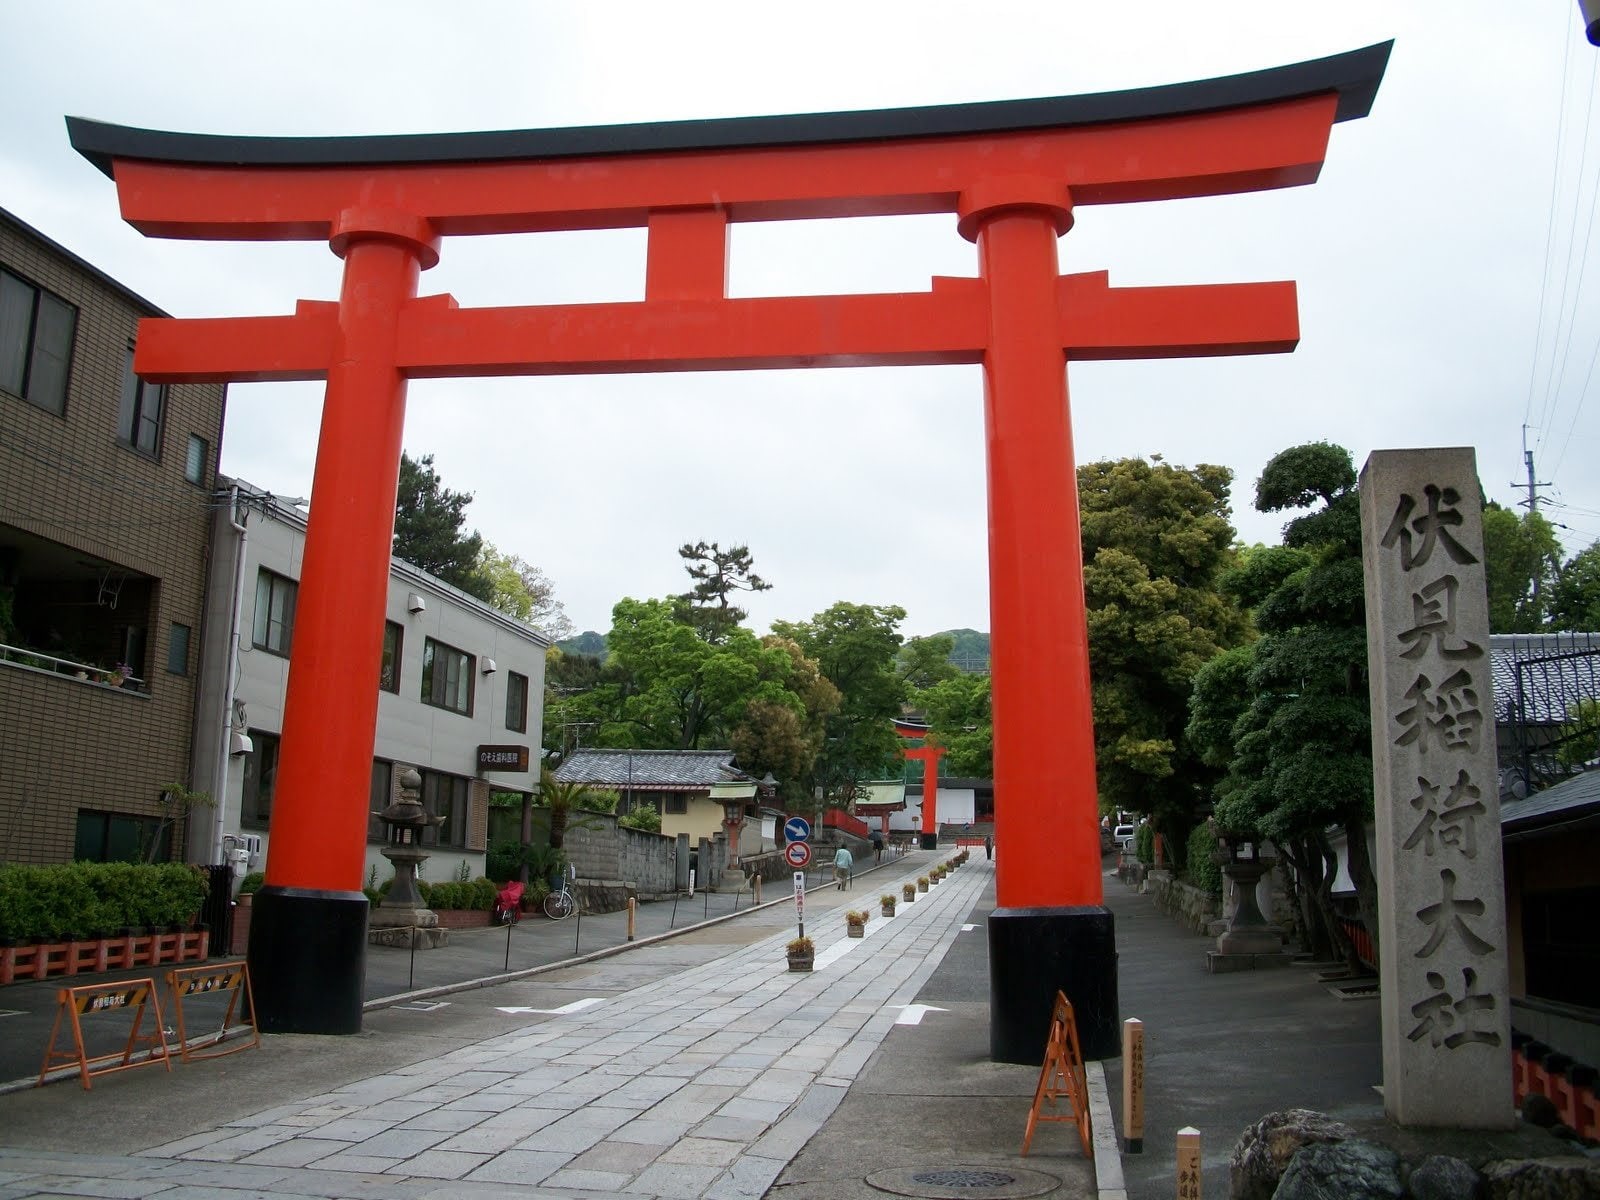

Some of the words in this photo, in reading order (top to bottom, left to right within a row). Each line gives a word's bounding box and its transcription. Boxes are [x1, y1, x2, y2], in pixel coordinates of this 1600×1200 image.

[1381, 483, 1501, 1049] 伏見稲荷大社
